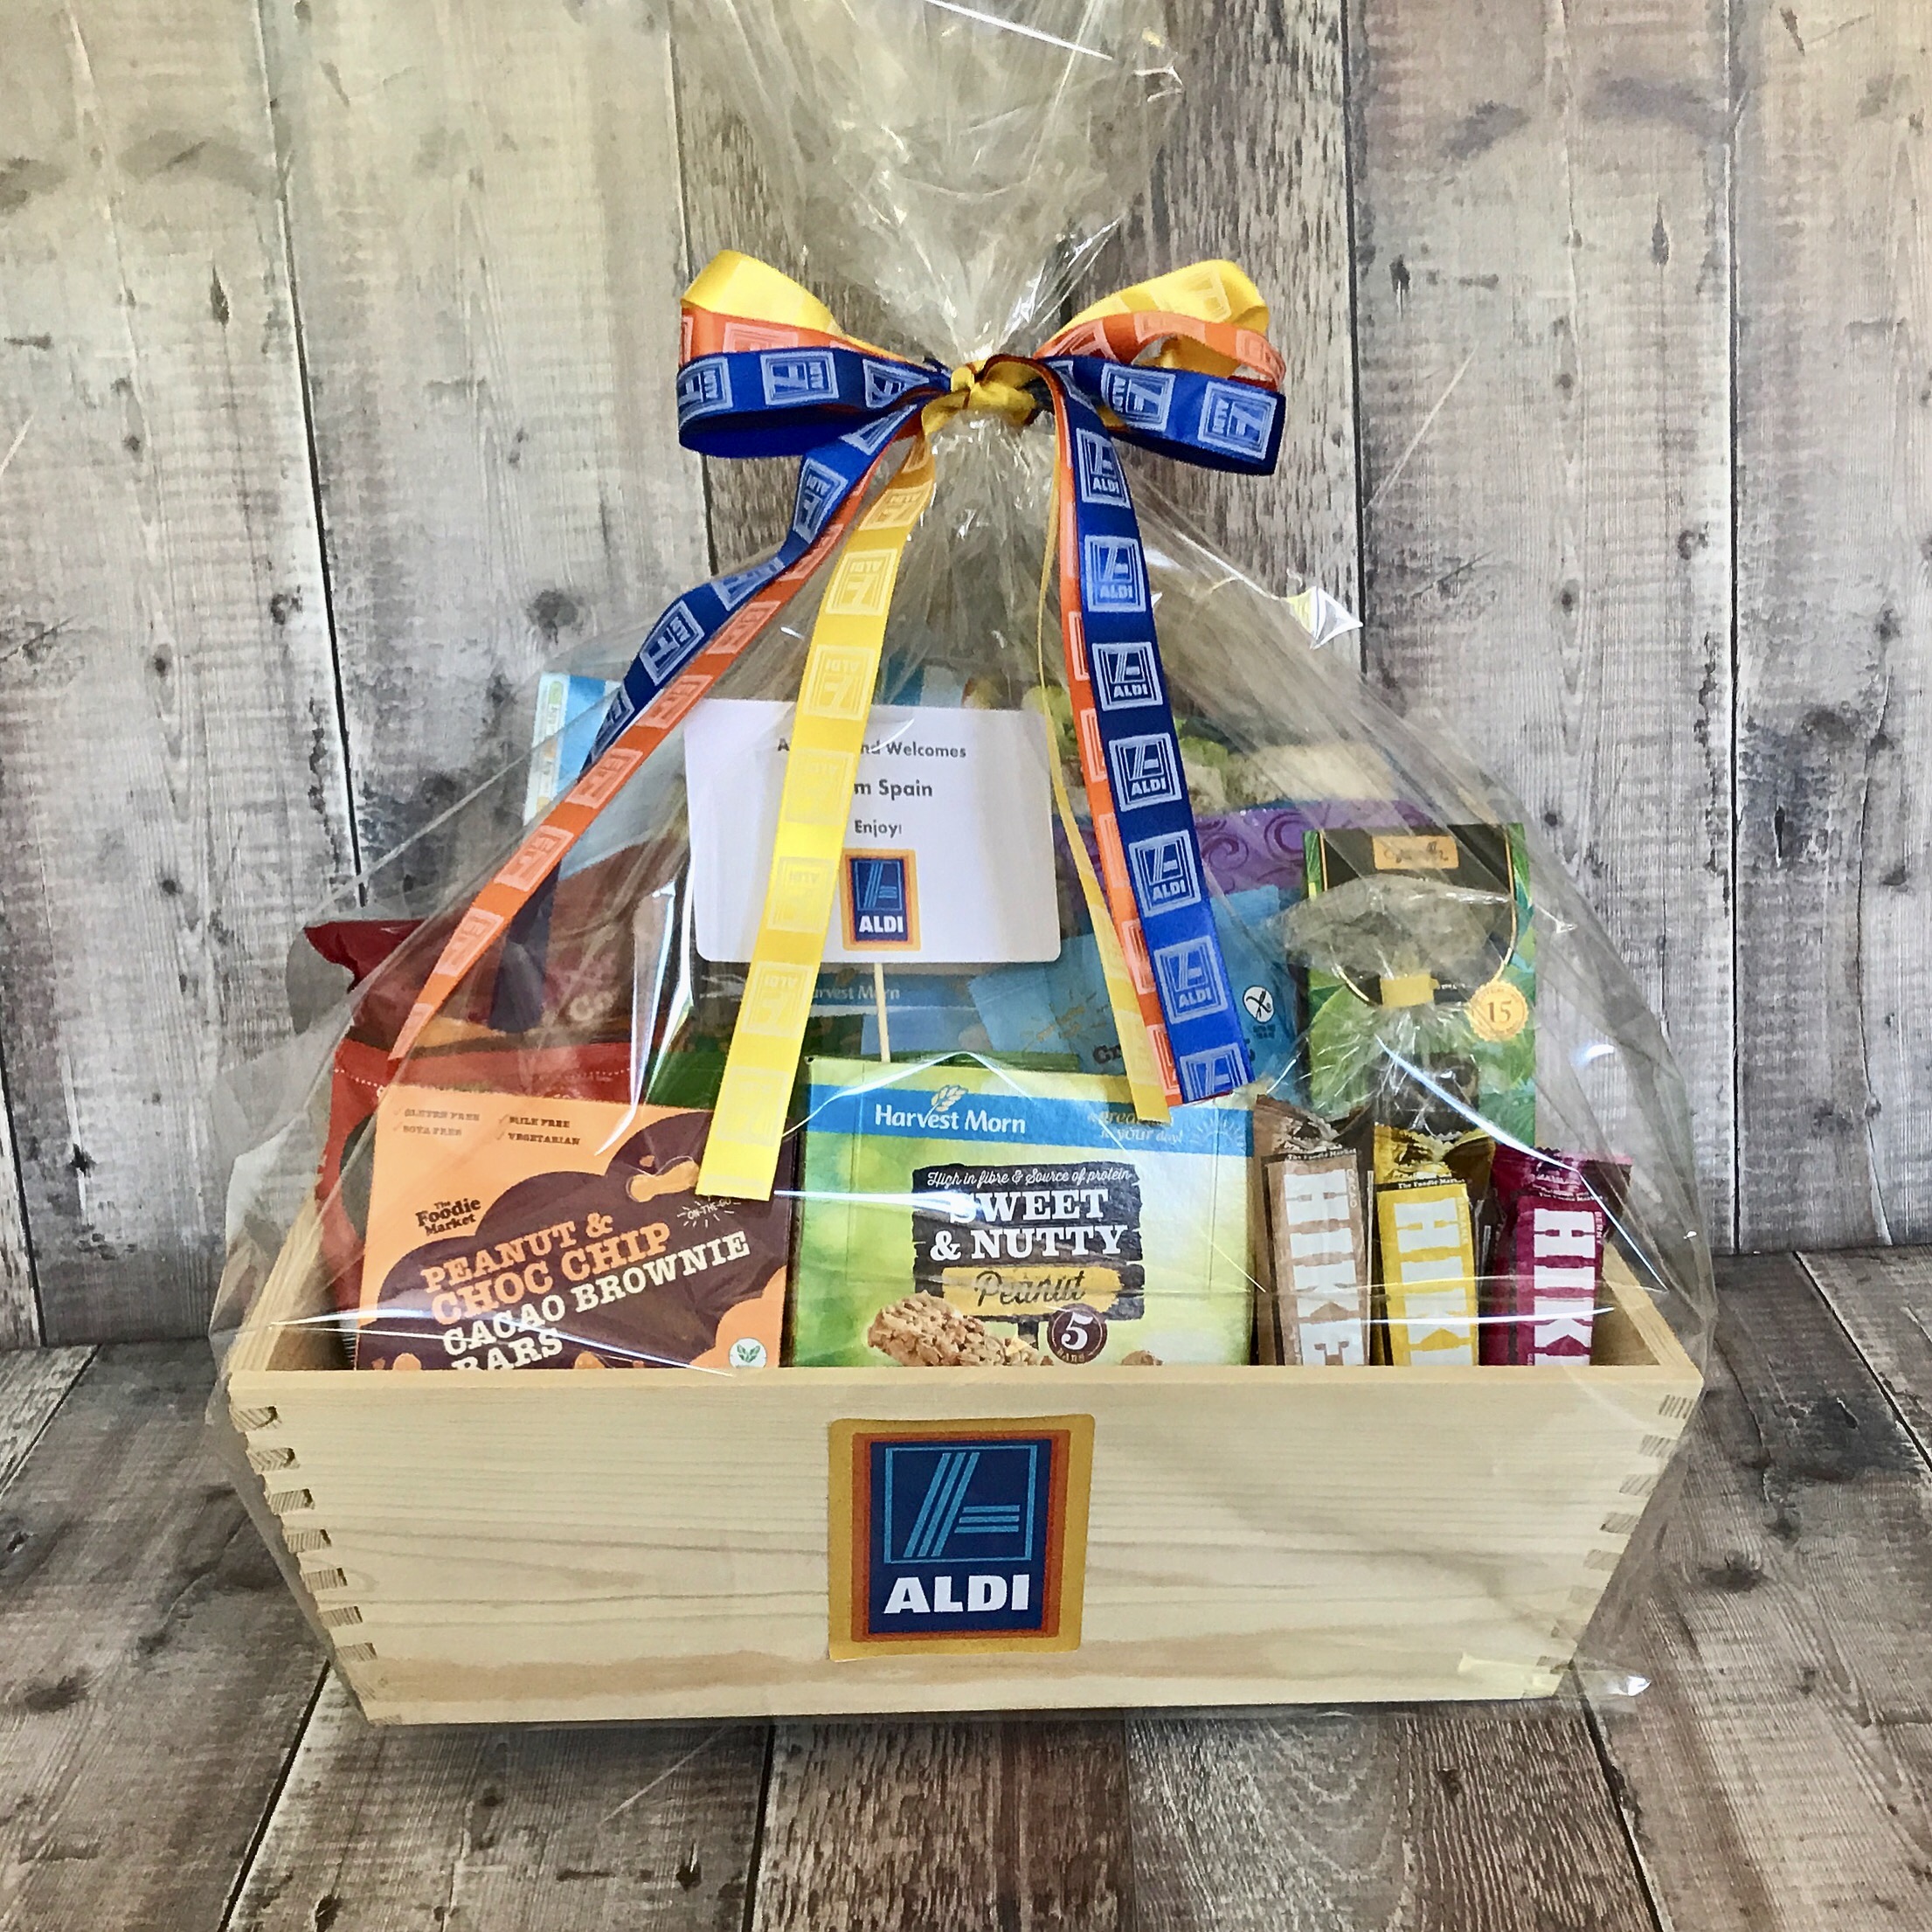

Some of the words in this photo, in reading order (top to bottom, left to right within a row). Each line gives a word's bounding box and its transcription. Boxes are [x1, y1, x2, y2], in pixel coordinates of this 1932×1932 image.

[1093, 477, 1119, 494] ALDI
[1099, 585, 1133, 599] ALDI
[1113, 683, 1148, 697] ALDI
[887, 742, 966, 758] Welcomes
[878, 779, 932, 800] Spain
[1131, 778, 1167, 797] ALDI
[1153, 881, 1186, 902] ALDI
[858, 915, 904, 933] ALDI
[1179, 987, 1212, 1008] ALDI
[1488, 1001, 1512, 1023] 15
[541, 1118, 570, 1128] FREE
[876, 1104, 959, 1130] Harvest
[965, 1110, 1026, 1134] Morn
[508, 1132, 580, 1146] VEGETARIAN
[927, 1171, 962, 1189] High
[963, 1172, 977, 1185] in
[977, 1170, 1009, 1189] fibre
[1012, 1169, 1023, 1183] &
[1025, 1167, 1070, 1184] Source
[1071, 1167, 1087, 1188] of
[1087, 1167, 1132, 1186] protein
[1347, 1168, 1358, 1208] CACAO
[415, 1198, 481, 1227] Foodie
[434, 1201, 451, 1209] The
[425, 1214, 476, 1236] Market
[421, 1222, 577, 1292] PEANUT
[586, 1212, 613, 1237] &
[929, 1230, 962, 1261] &
[970, 1225, 1128, 1260] NUTTY
[432, 1259, 553, 1325] CHOC
[560, 1222, 671, 1282] CHIP
[1393, 1198, 1472, 1366] HIK
[443, 1295, 565, 1355] CACAO
[571, 1230, 751, 1312] BROWNIE
[974, 1270, 1086, 1306] Peanut
[1534, 1208, 1596, 1366] HIK
[1061, 1311, 1093, 1350] 5
[883, 1575, 1030, 1614] ALDI
